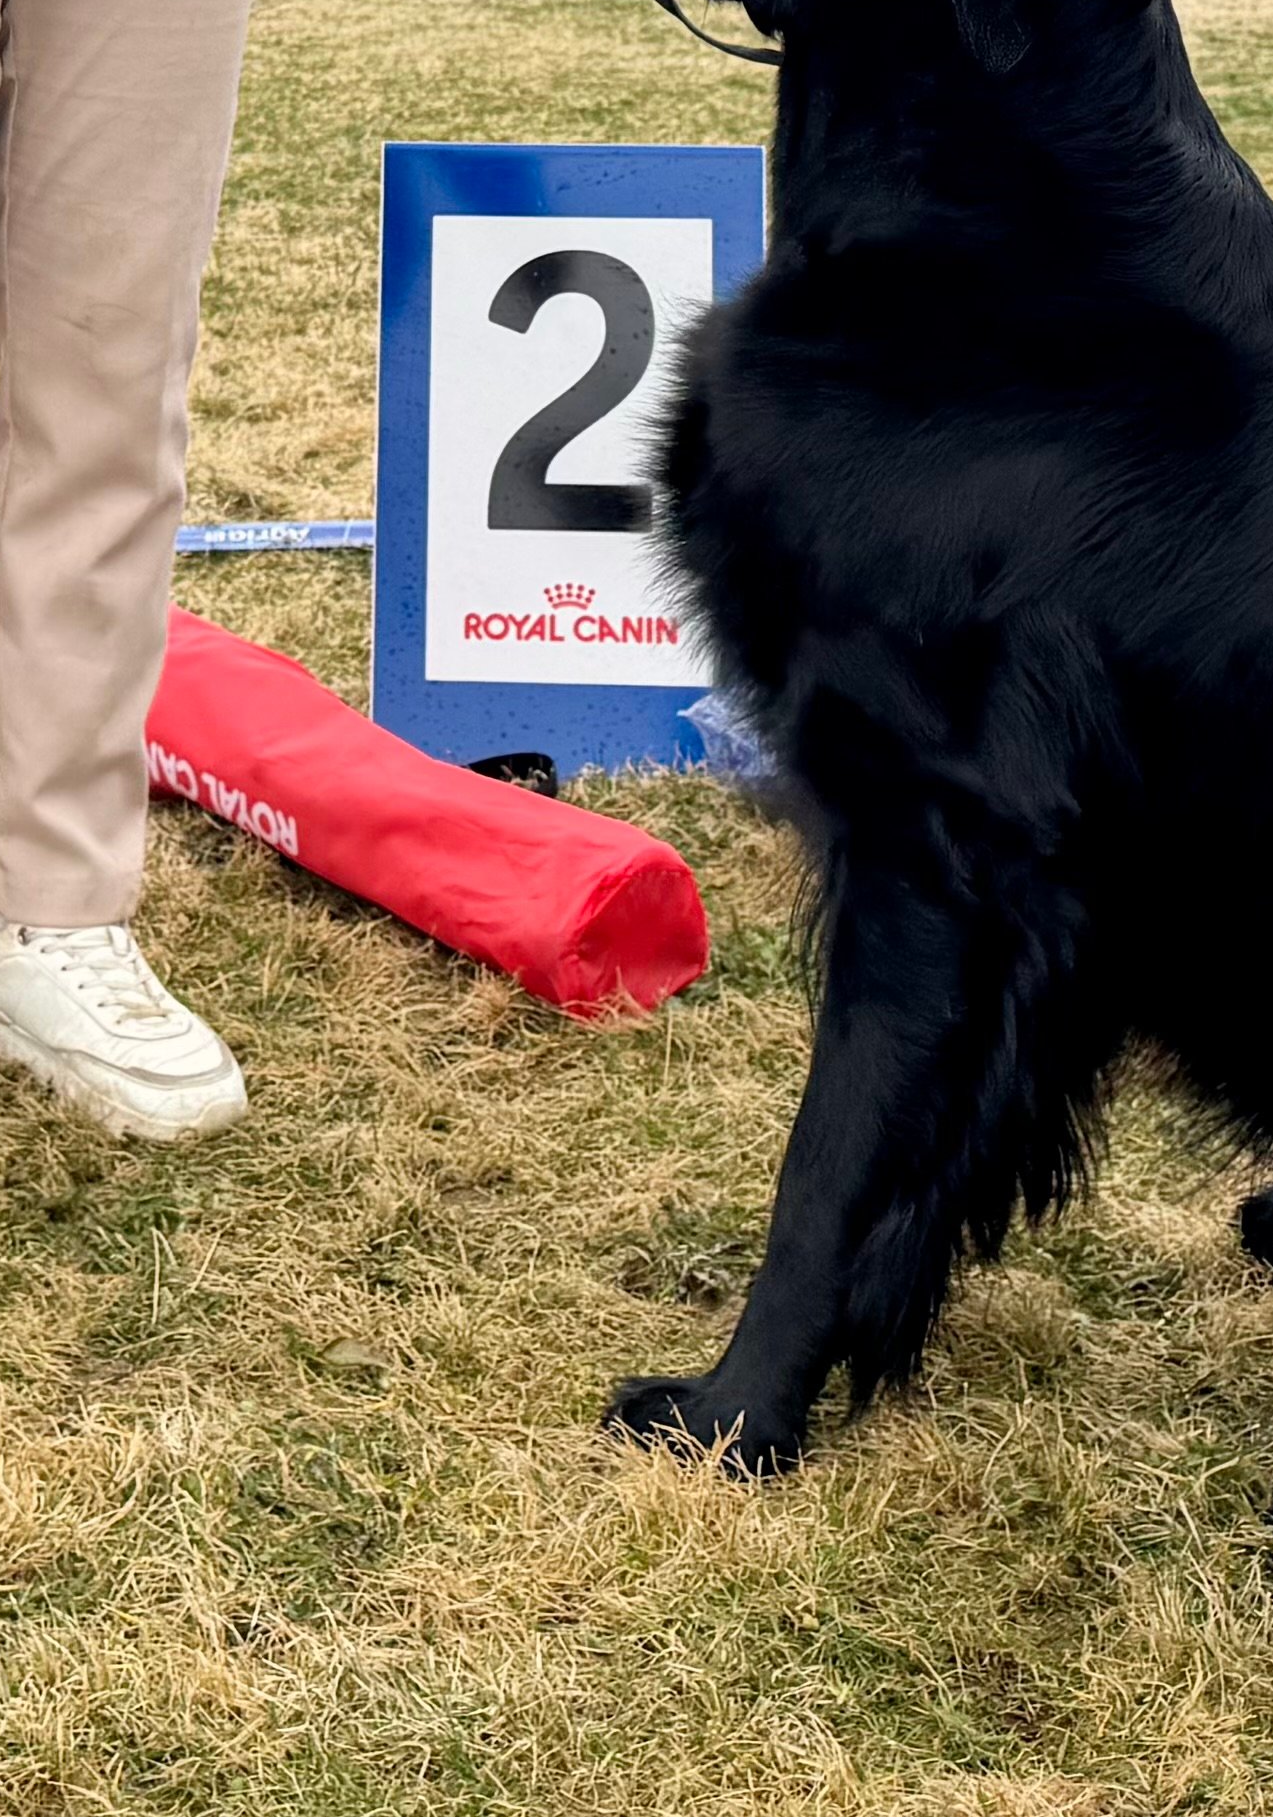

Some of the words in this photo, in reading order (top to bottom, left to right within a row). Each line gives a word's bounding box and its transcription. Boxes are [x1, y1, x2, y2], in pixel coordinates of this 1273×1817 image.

[488, 250, 655, 531] 2
[464, 612, 565, 641] ROYAL
[573, 615, 678, 644] CANIN
[201, 772, 299, 856] ROYAL
